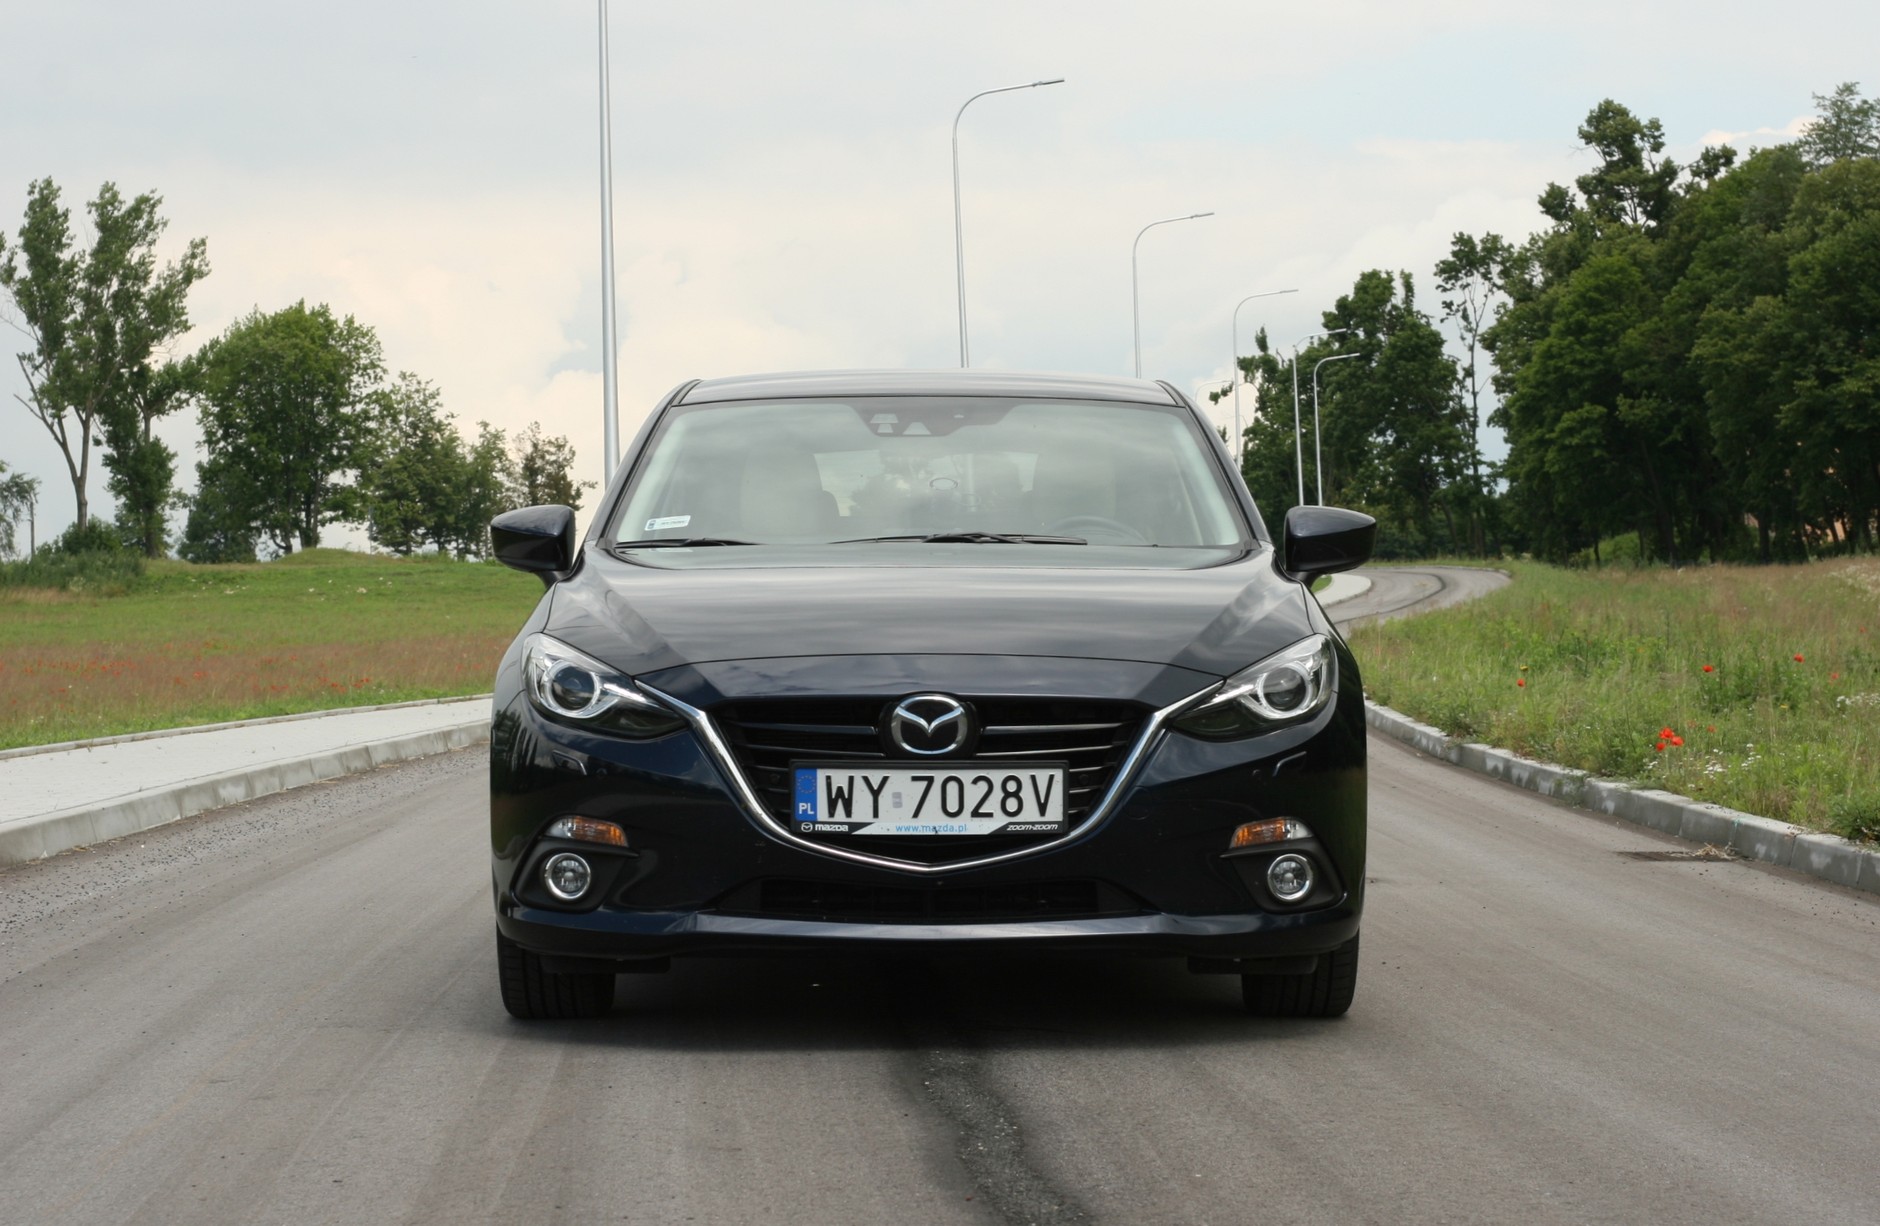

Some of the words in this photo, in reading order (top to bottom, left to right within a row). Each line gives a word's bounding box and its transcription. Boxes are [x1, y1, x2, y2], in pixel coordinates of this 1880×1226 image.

[825, 775, 890, 819] WY
[911, 774, 1055, 819] 7028V
[799, 803, 814, 815] PL
[896, 824, 967, 833] www.mazda.pl
